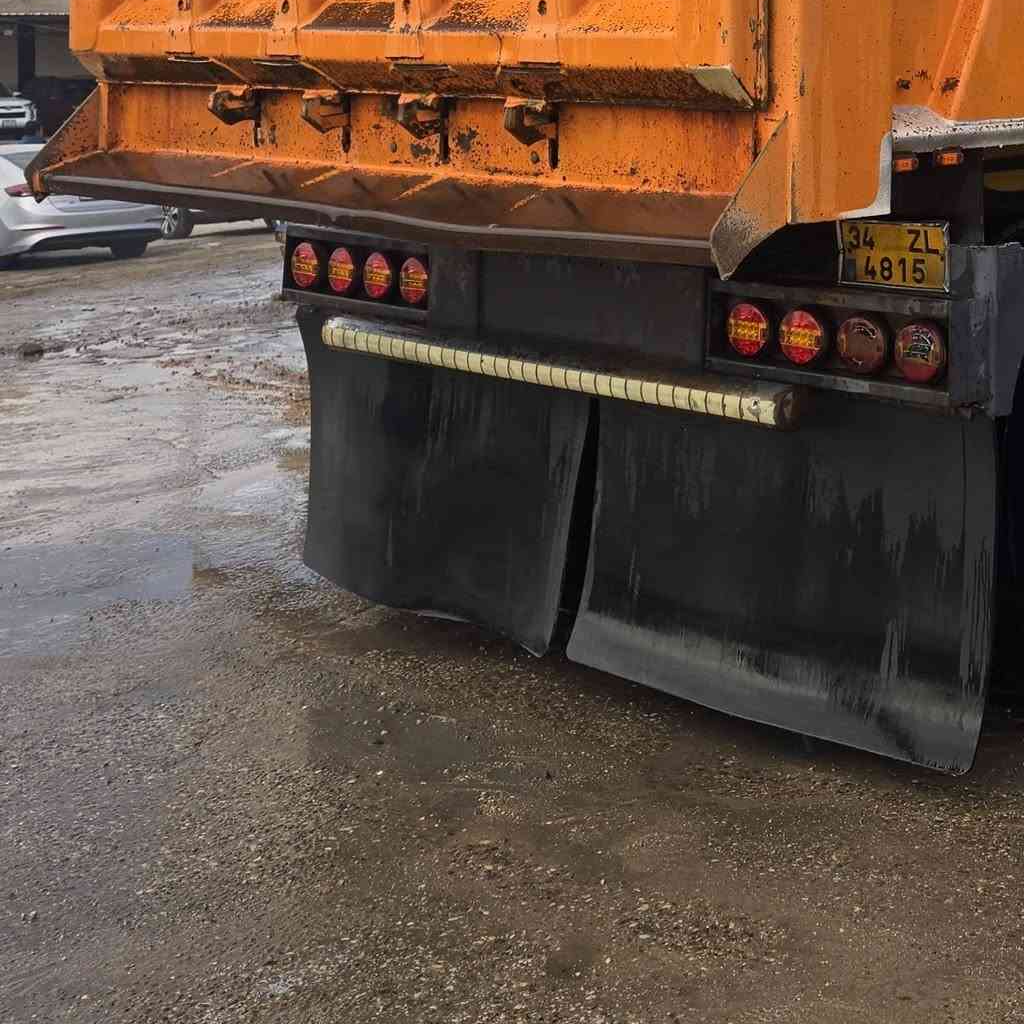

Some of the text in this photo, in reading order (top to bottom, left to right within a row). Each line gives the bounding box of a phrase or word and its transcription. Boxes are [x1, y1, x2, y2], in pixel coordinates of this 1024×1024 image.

[848, 225, 940, 255] 34 ZL
[864, 256, 926, 284] 4815
